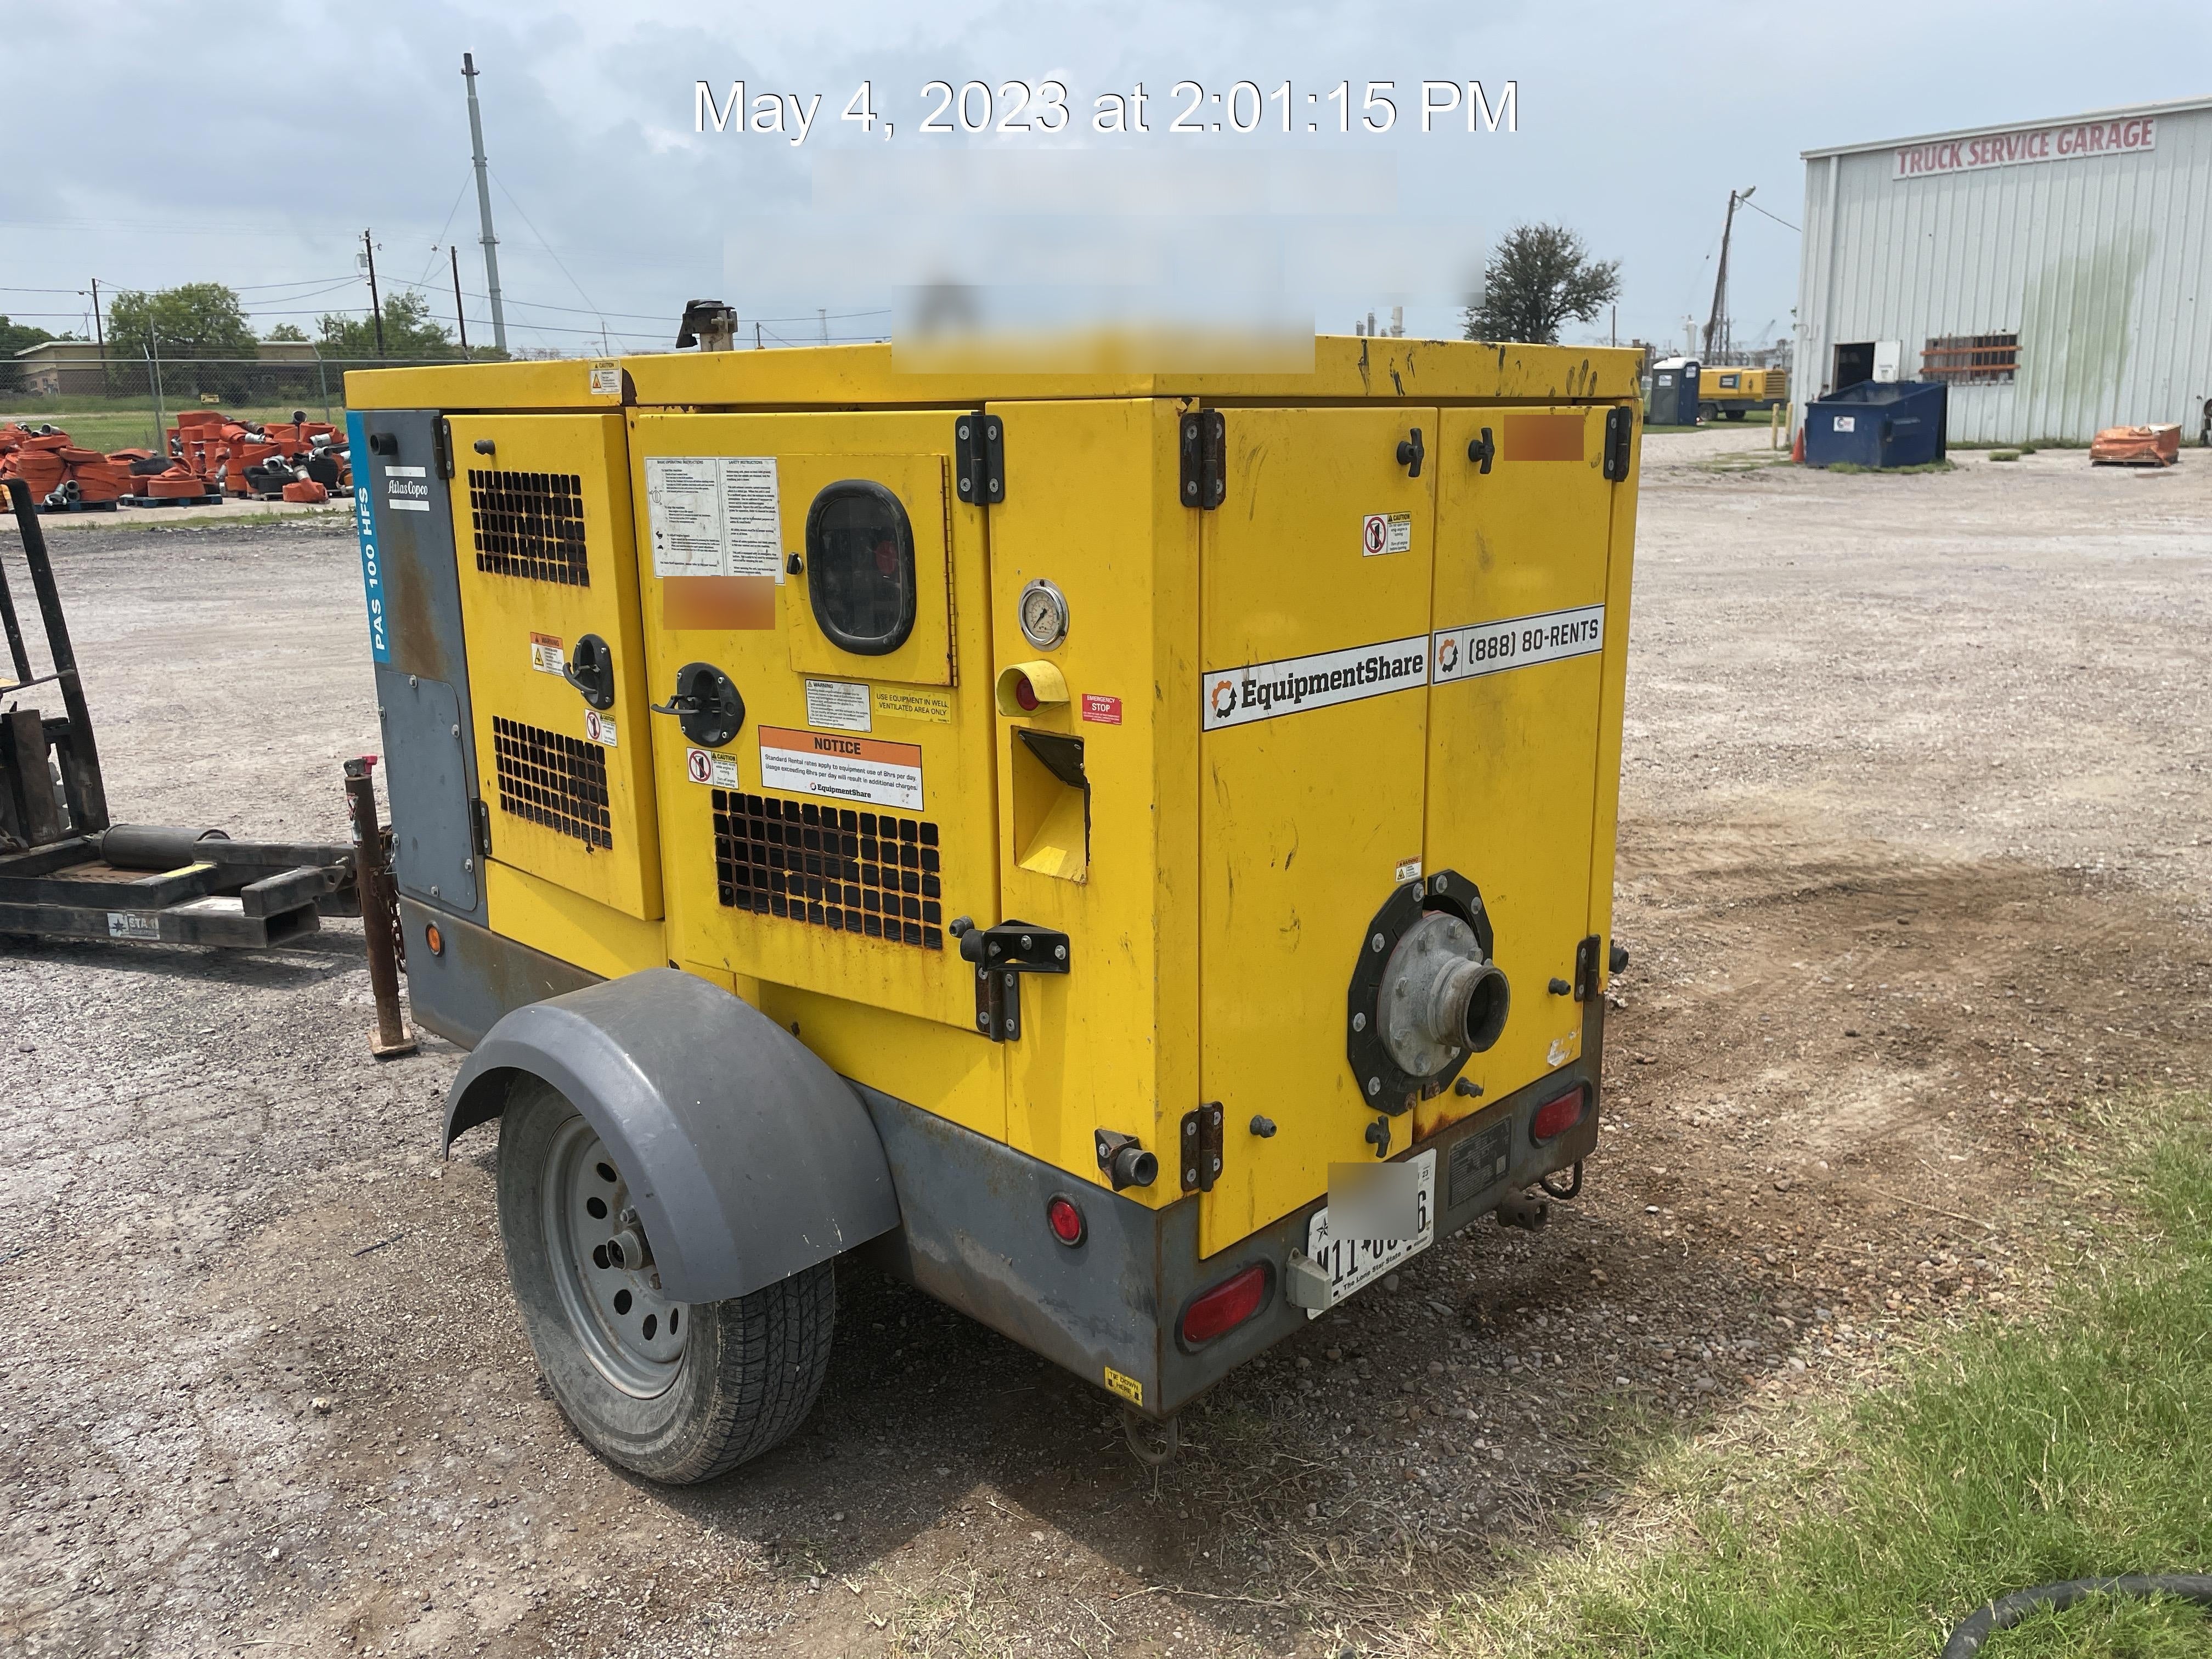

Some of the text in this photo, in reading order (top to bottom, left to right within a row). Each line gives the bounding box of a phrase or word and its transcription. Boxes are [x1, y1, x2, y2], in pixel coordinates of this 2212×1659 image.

[1897, 118, 2153, 174] TRUCK SERVICE GARAGE
[388, 479, 428, 498] Atlas Copco
[359, 487, 385, 650] PAS 100 HFS
[1469, 619, 1598, 664] (888) 80-RENTS
[1242, 654, 1423, 710] EquipmentShare
[879, 702, 913, 712] VENTILATED
[889, 695, 923, 704] EQUIPMENT
[1087, 695, 1115, 703] EMERGENCY
[1092, 703, 1110, 712] STOP
[814, 737, 861, 755] NOTICE
[765, 754, 787, 763] Standard
[839, 764, 865, 774] equipment
[765, 763, 780, 771] Usage
[781, 766, 805, 775] exceeding
[869, 778, 894, 787] additional
[817, 783, 871, 798] EquipmentShare
[1422, 1169, 1429, 1178] 23
[1343, 1252, 1401, 1291] The Long Star State
[1109, 1372, 1138, 1391] TIE DOWN
[1116, 1382, 1131, 1394] HERE
